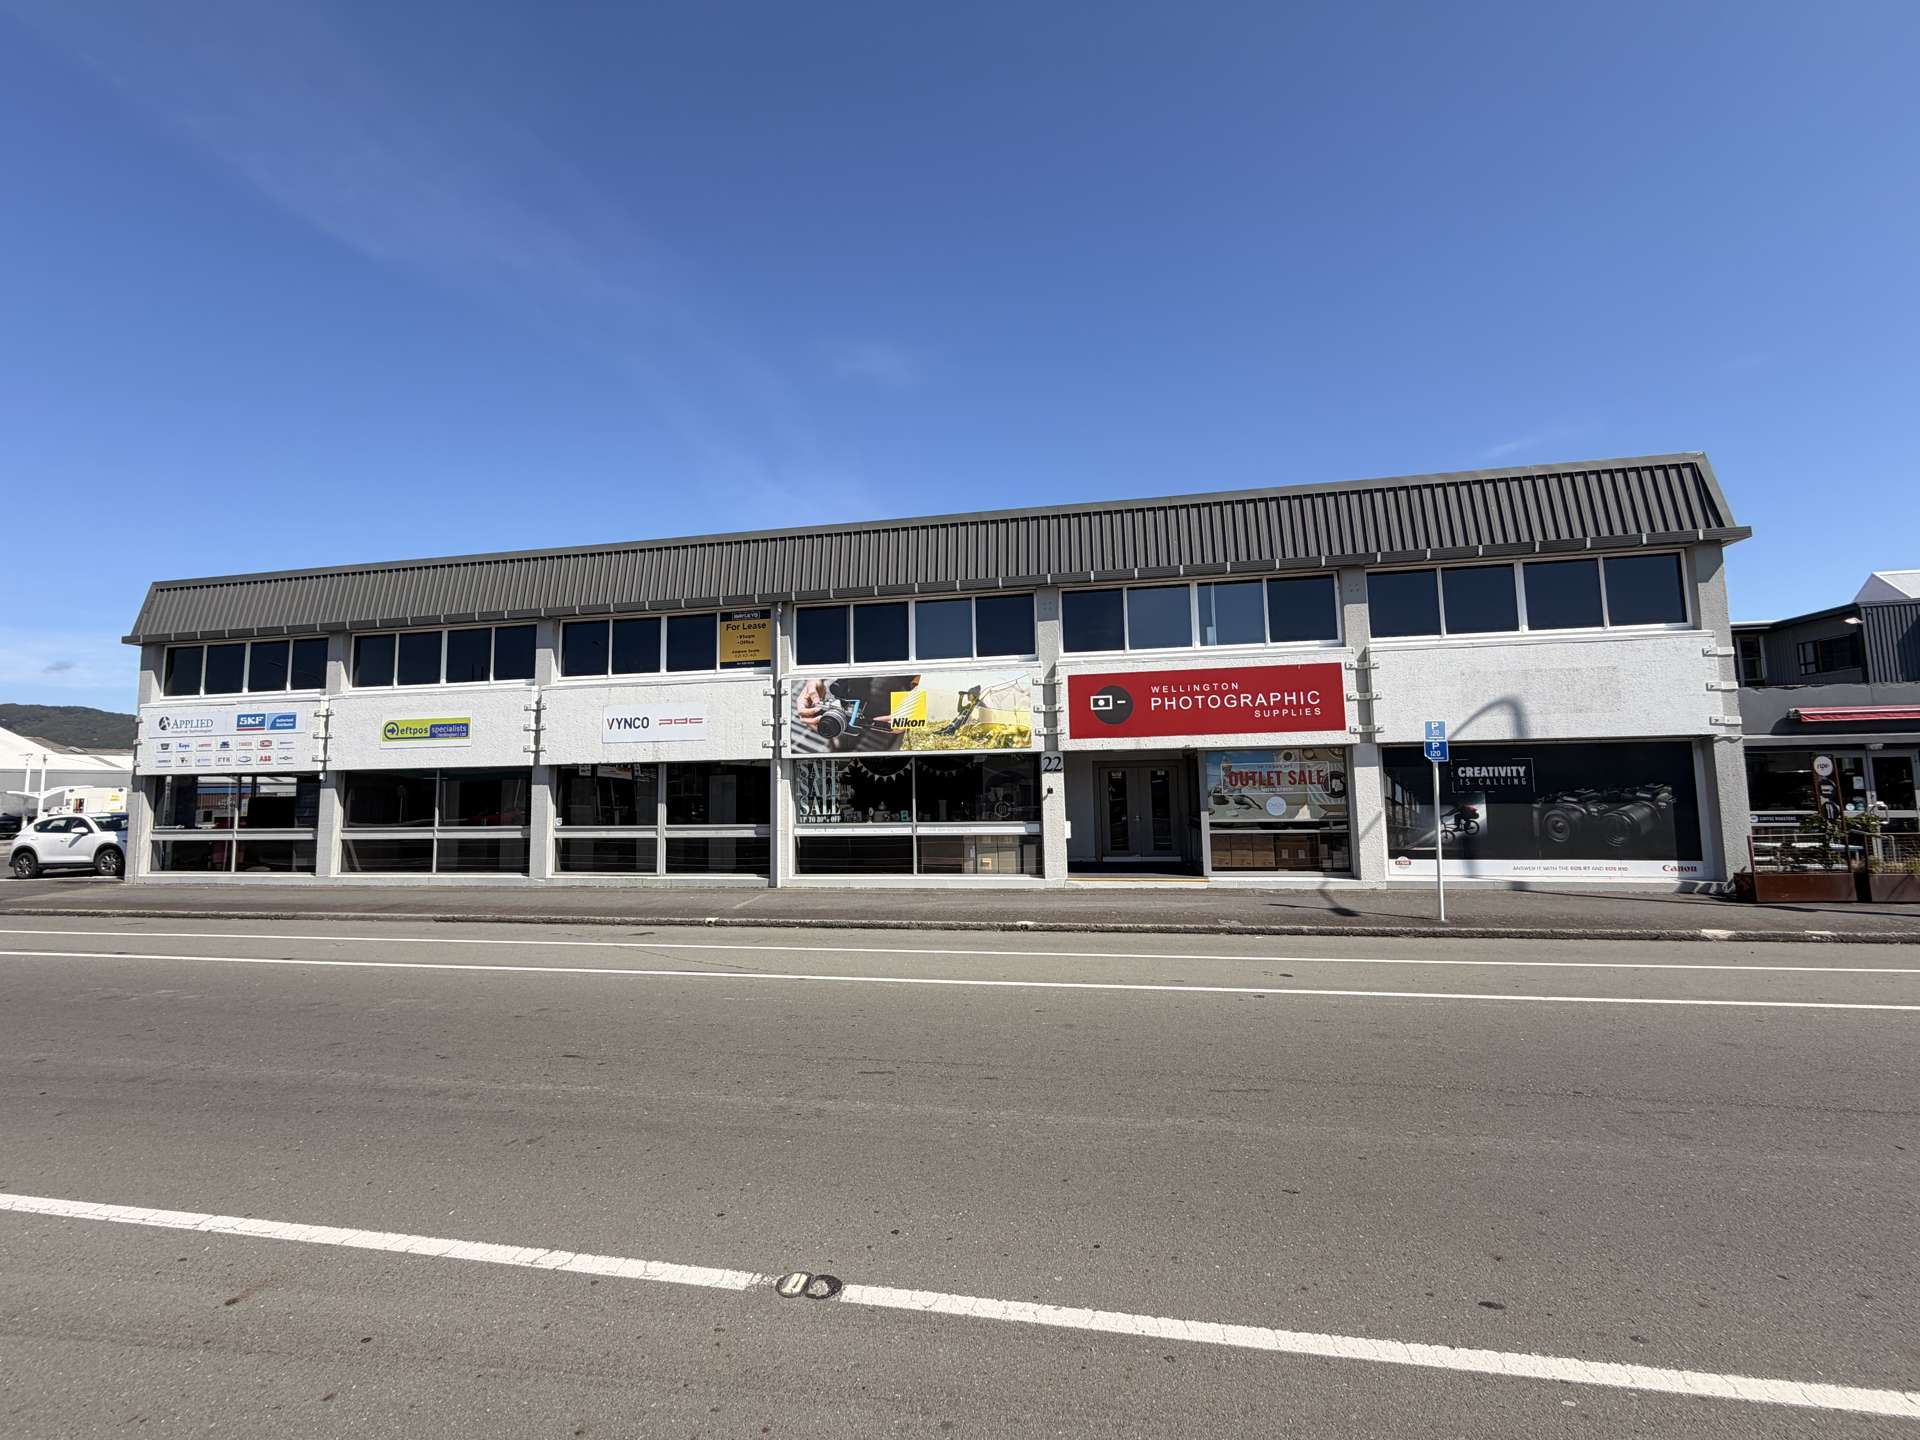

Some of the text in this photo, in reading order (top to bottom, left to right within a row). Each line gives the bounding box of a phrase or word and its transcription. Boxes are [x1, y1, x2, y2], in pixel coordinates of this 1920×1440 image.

[726, 622, 767, 631] For Lease
[1151, 682, 1239, 693] WELLINGTON
[1151, 690, 1321, 711] PHOTOGRAPHIC
[1254, 707, 1321, 718] SUPPLIES
[172, 718, 214, 729] APPLIED
[240, 716, 264, 725] SKF
[606, 716, 650, 730] VYNCO
[892, 717, 926, 728] Nikon
[1431, 721, 1440, 730] P
[400, 726, 428, 736] eftpos
[431, 724, 467, 735] specialists
[1432, 742, 1440, 751] P
[1042, 756, 1063, 772] 22
[1457, 765, 1526, 778] CREATIVITY
[1228, 768, 1325, 787] OUTLET SALE
[1460, 777, 1527, 786] IS CALLING
[799, 778, 841, 797] SALE
[799, 796, 841, 815] SALE
[830, 815, 841, 823] OFF
[1662, 864, 1697, 873] Canon
